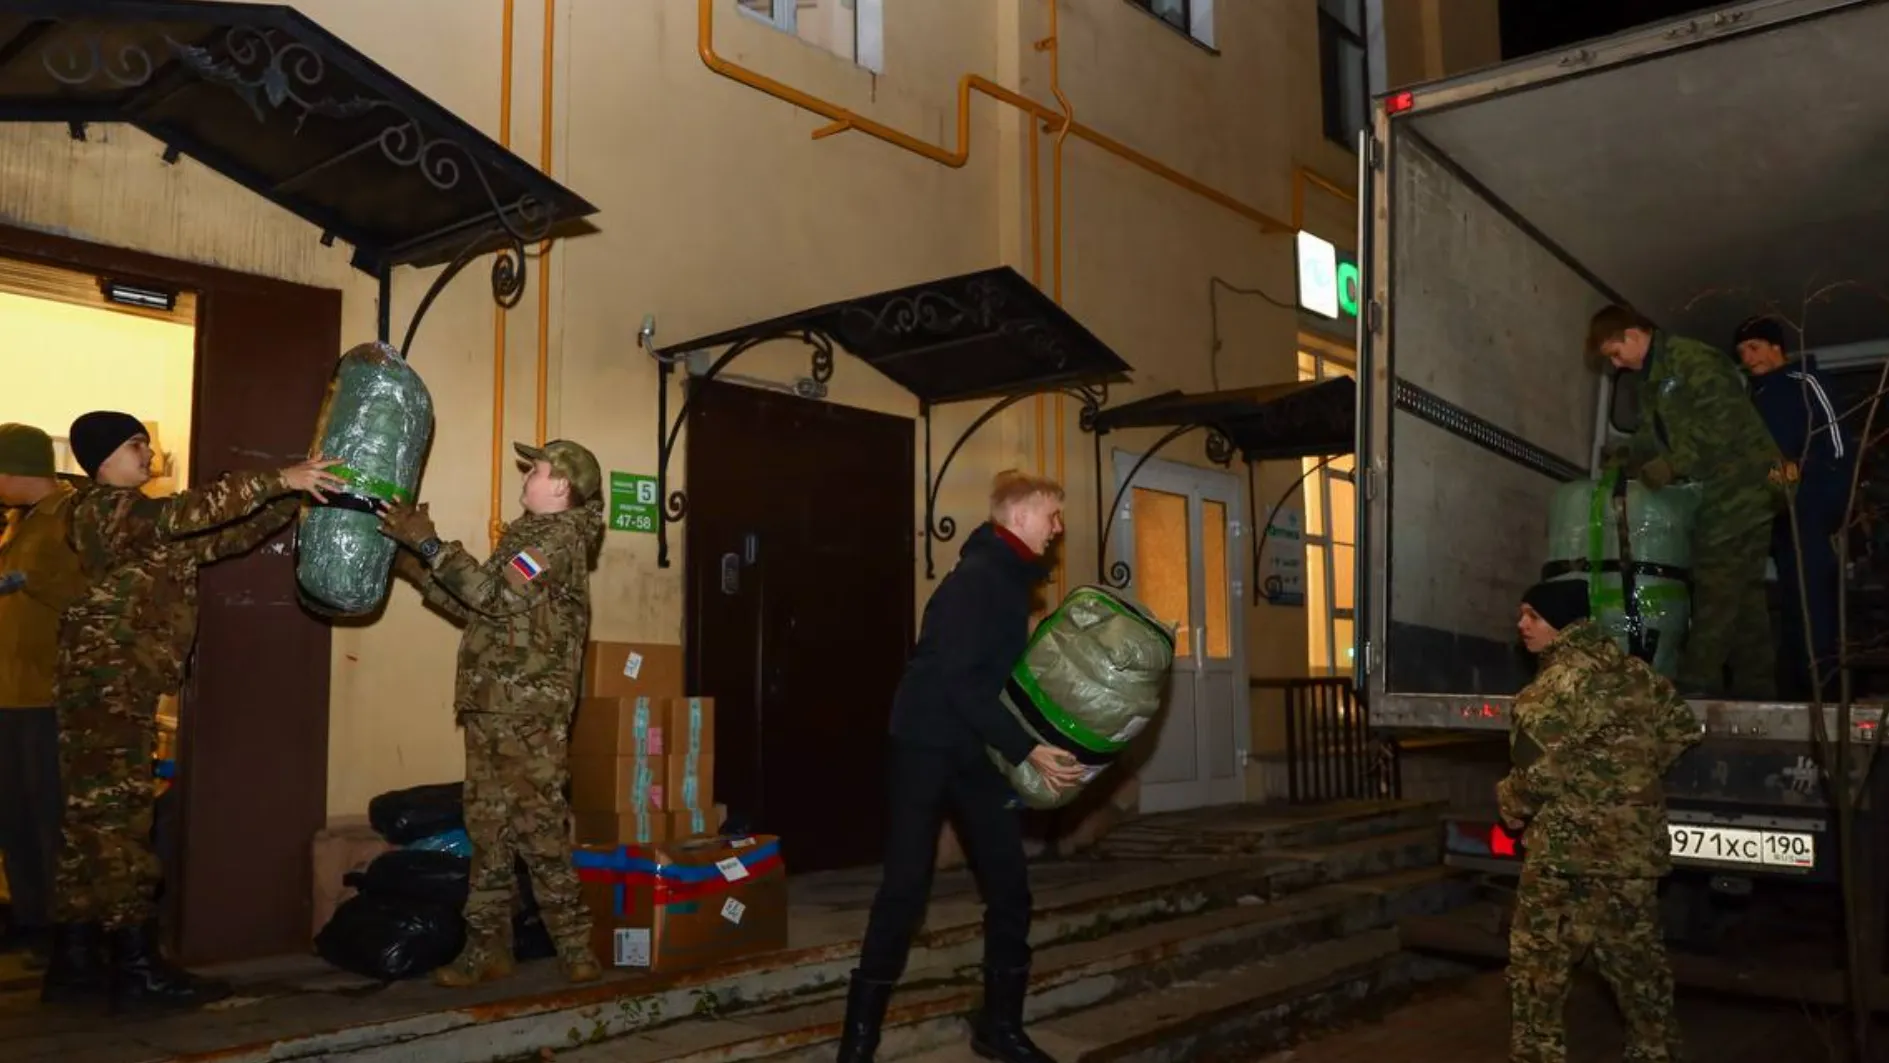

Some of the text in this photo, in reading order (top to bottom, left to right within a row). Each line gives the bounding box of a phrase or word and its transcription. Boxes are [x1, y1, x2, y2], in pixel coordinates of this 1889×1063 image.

[642, 484, 651, 501] 5
[616, 514, 651, 529] 47-58
[1765, 835, 1804, 855] 190
[1774, 854, 1795, 862] RUS
